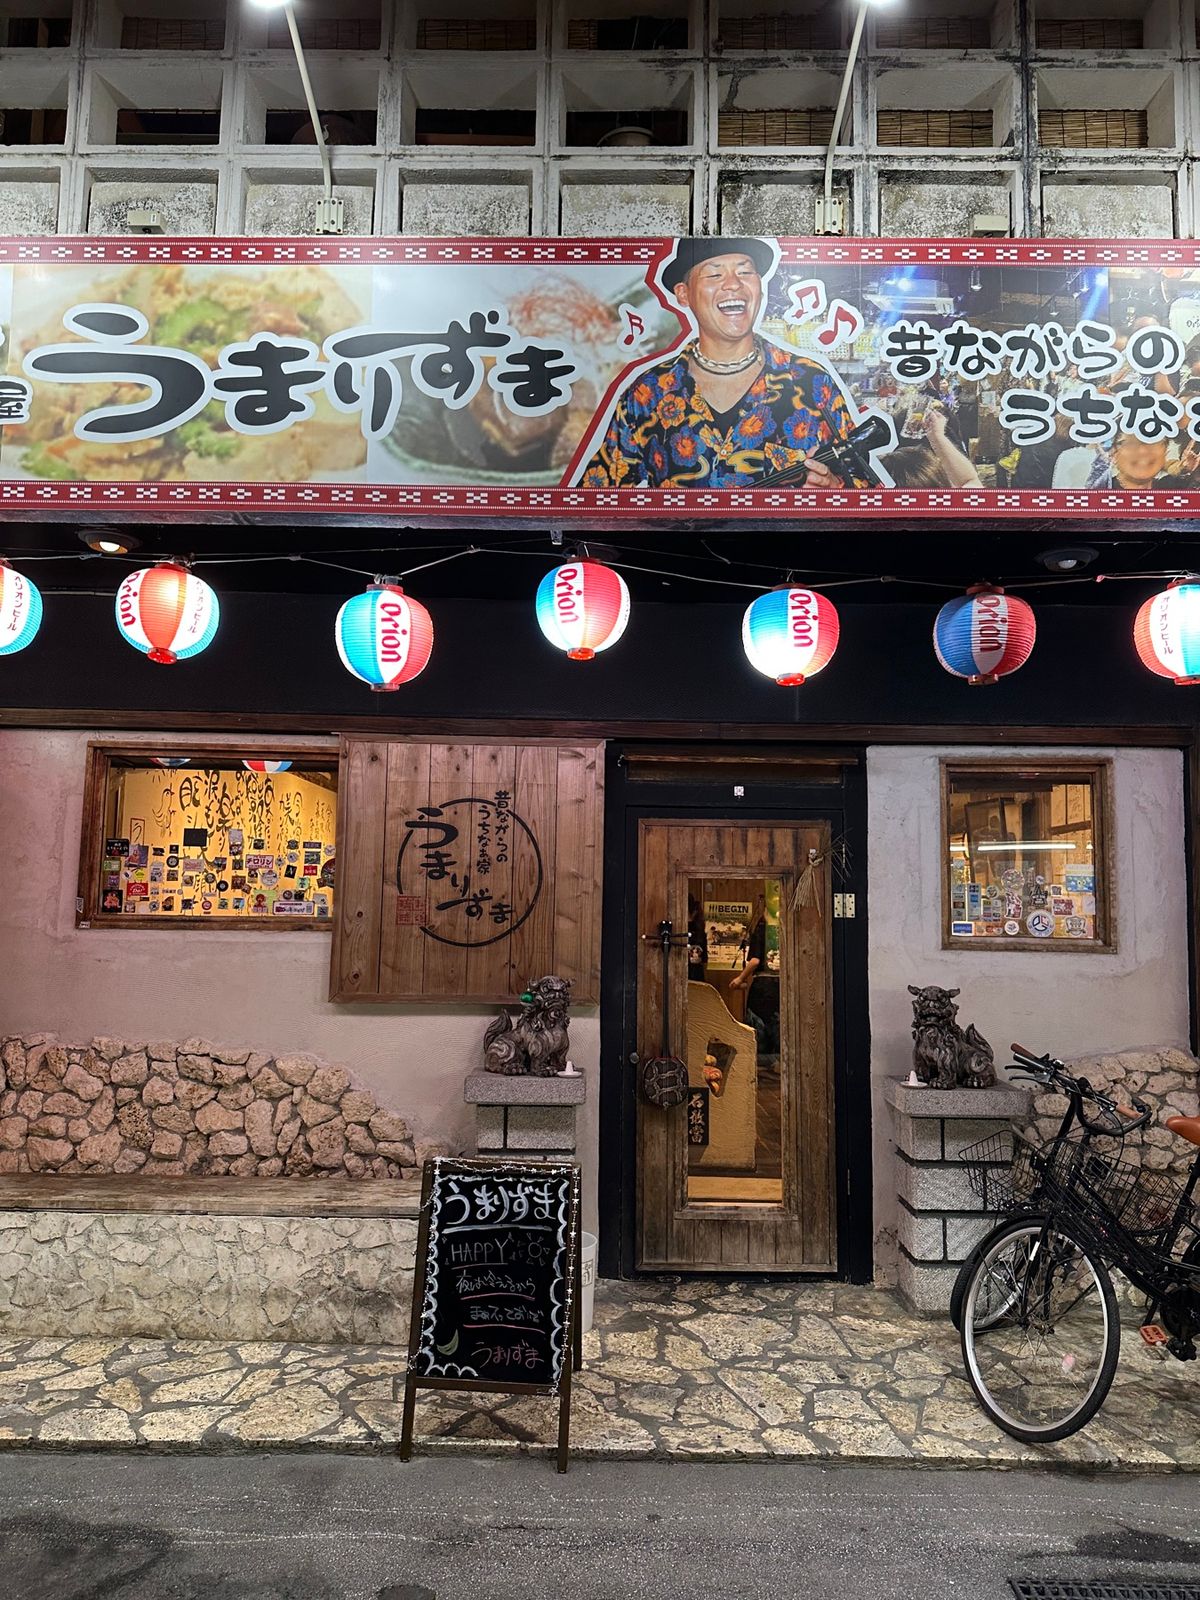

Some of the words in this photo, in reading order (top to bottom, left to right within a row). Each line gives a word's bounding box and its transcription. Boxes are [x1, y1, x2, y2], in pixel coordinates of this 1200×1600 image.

[30, 310, 576, 434] うまりずま
[886, 323, 1179, 376] 昔ながらの
[1004, 388, 1200, 438] うちな
[119, 571, 141, 628] Orion
[555, 567, 583, 624] Orion
[789, 592, 819, 648] Orion
[975, 594, 1008, 653] Orion
[379, 601, 408, 664] Orion
[1159, 595, 1174, 655] オリオンビール
[494, 790, 512, 864] 昔ながらの
[445, 1181, 557, 1225] うまりずま
[450, 1237, 509, 1264] HAPPY
[470, 1338, 546, 1369] うまりずま
